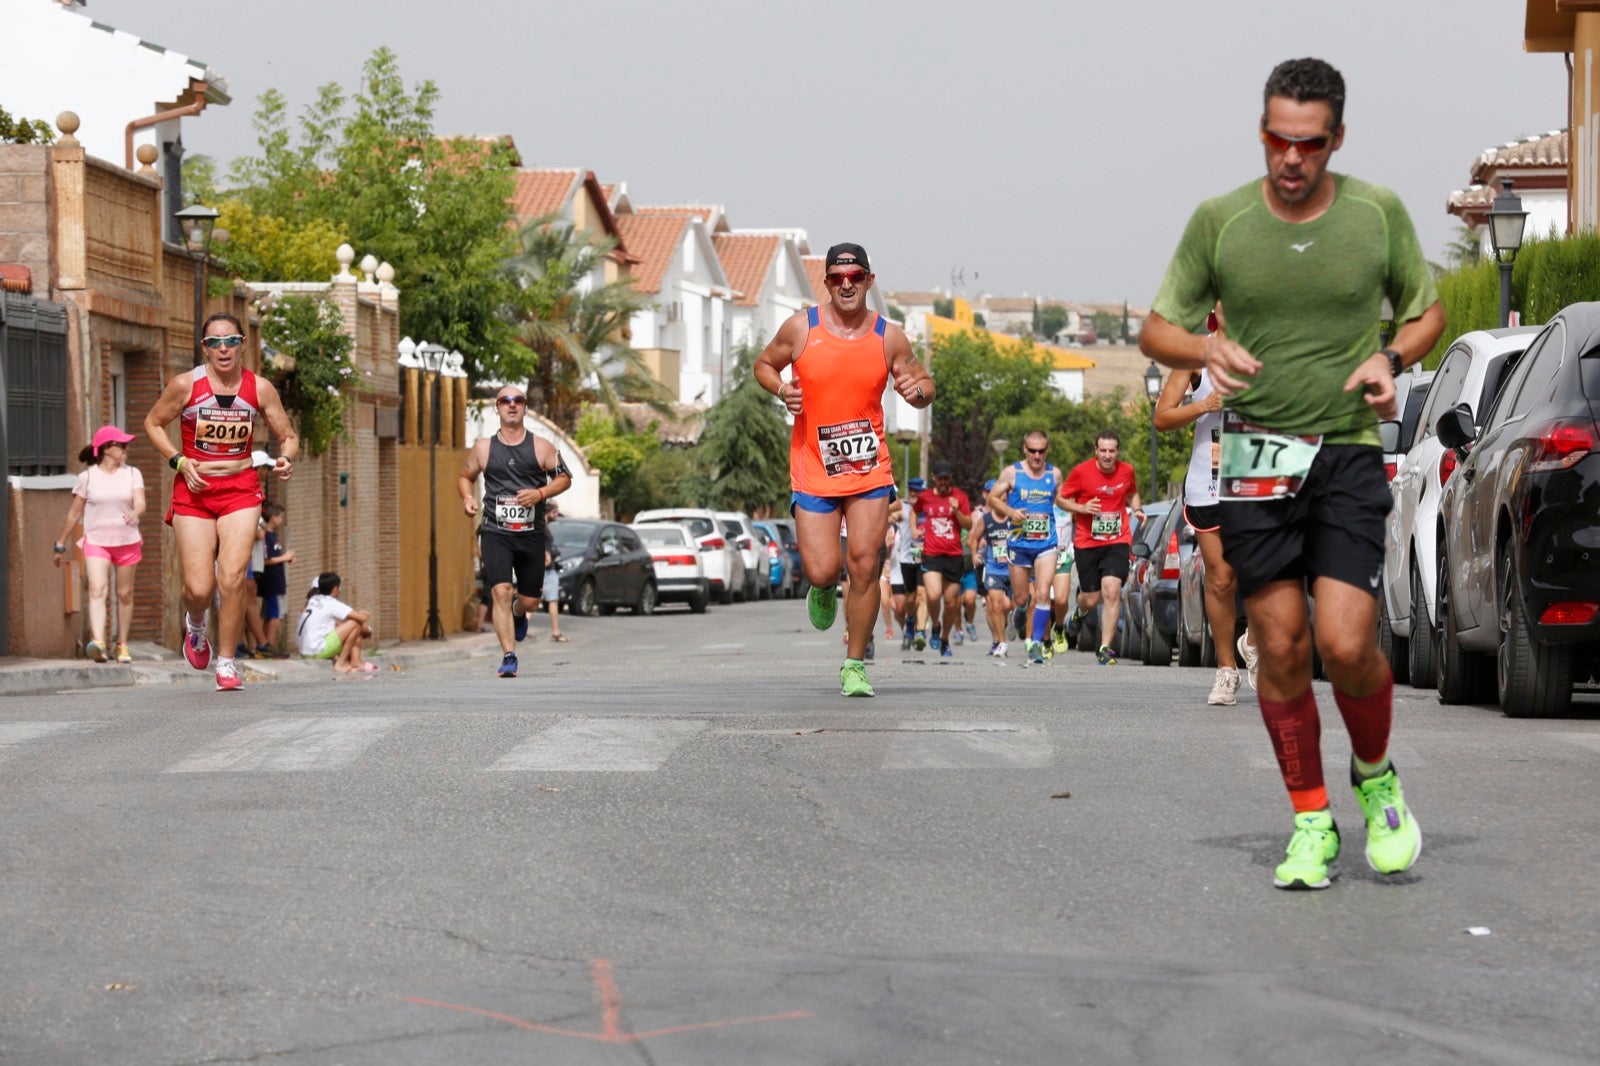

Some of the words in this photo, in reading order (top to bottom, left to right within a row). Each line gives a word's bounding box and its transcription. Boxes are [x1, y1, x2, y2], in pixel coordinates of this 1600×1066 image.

[205, 424, 249, 439] 2010
[827, 436, 877, 457] 3072
[1249, 438, 1289, 470] 77
[501, 507, 533, 519] 3027
[1027, 521, 1047, 531] 522
[1099, 521, 1118, 532] 552
[298, 609, 312, 636] 7
